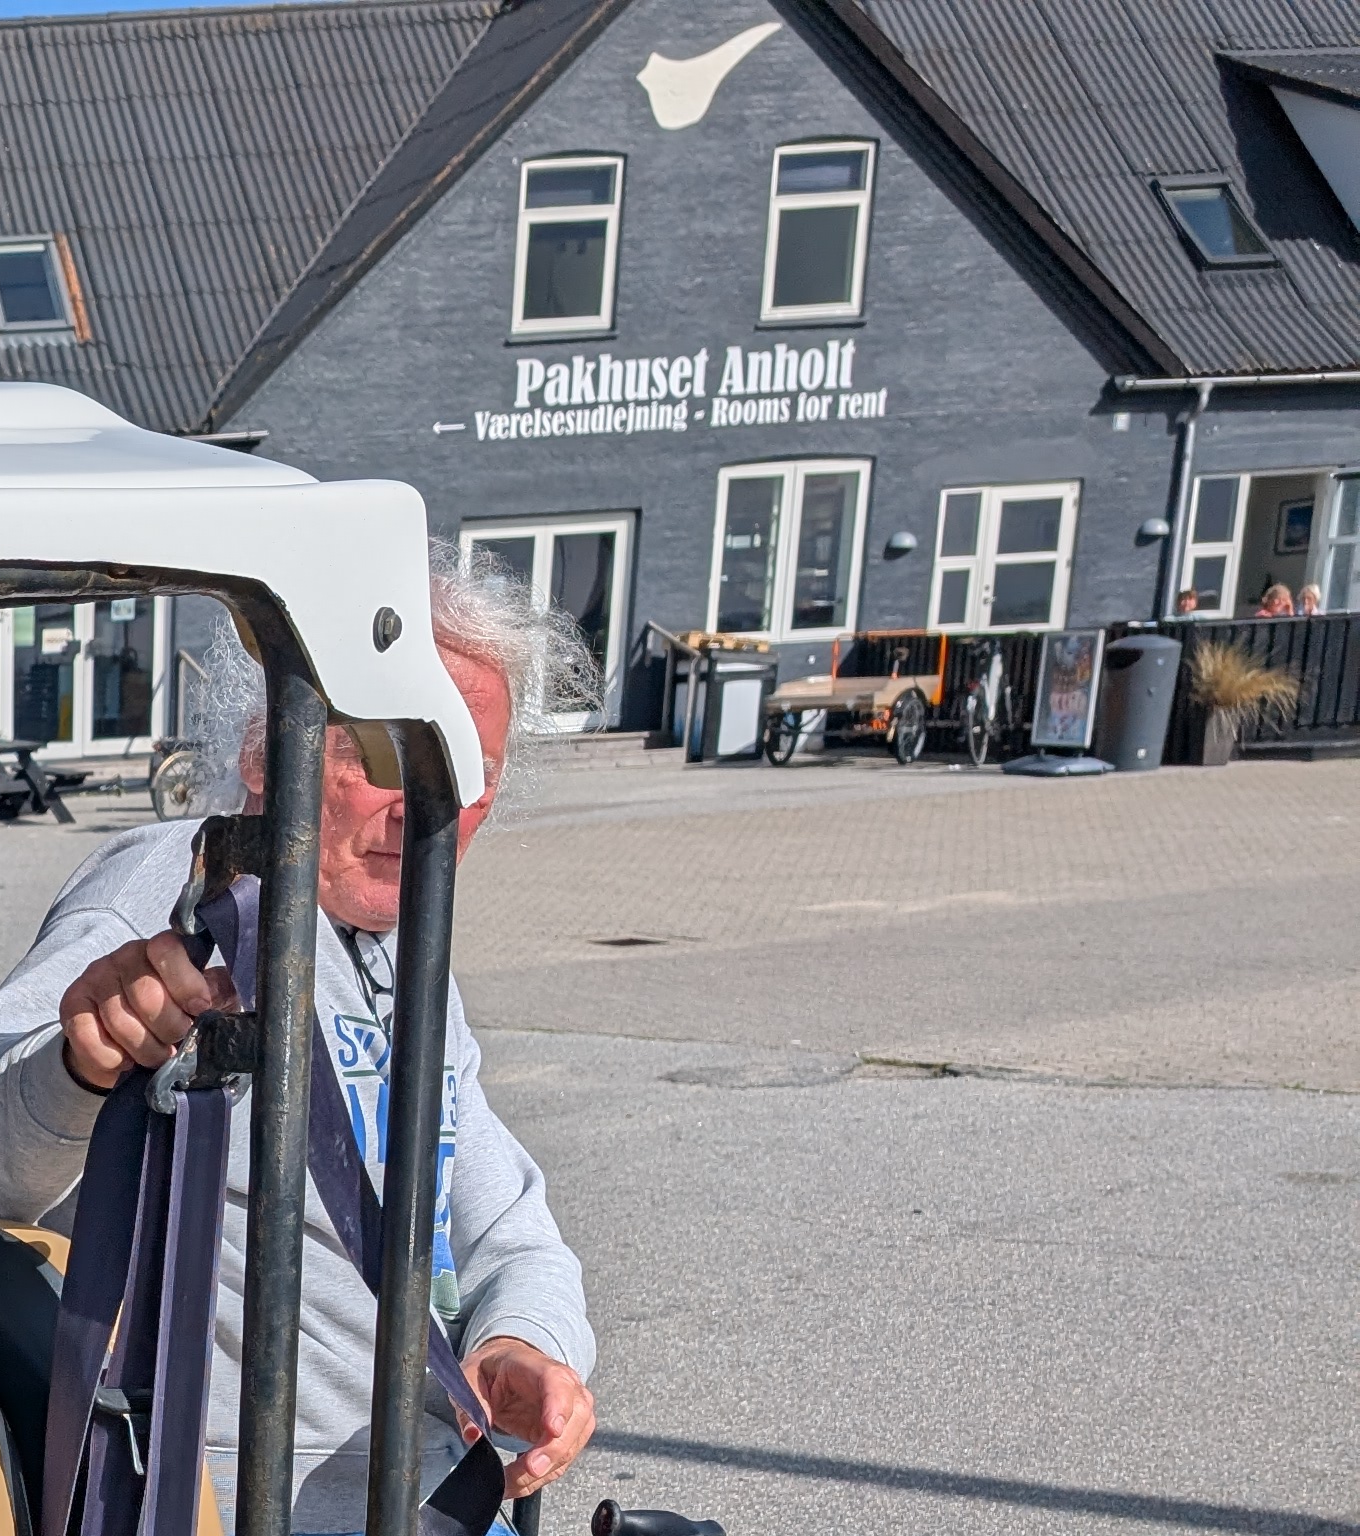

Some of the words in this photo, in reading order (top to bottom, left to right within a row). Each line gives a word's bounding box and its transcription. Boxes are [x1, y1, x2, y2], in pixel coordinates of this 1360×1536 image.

[514, 348, 709, 408] Pakhuset
[718, 338, 856, 396] Anholt
[475, 400, 688, 441] Værelsesudlejning
[710, 396, 791, 427] Rooms
[796, 391, 833, 422] for
[837, 387, 888, 420] rent
